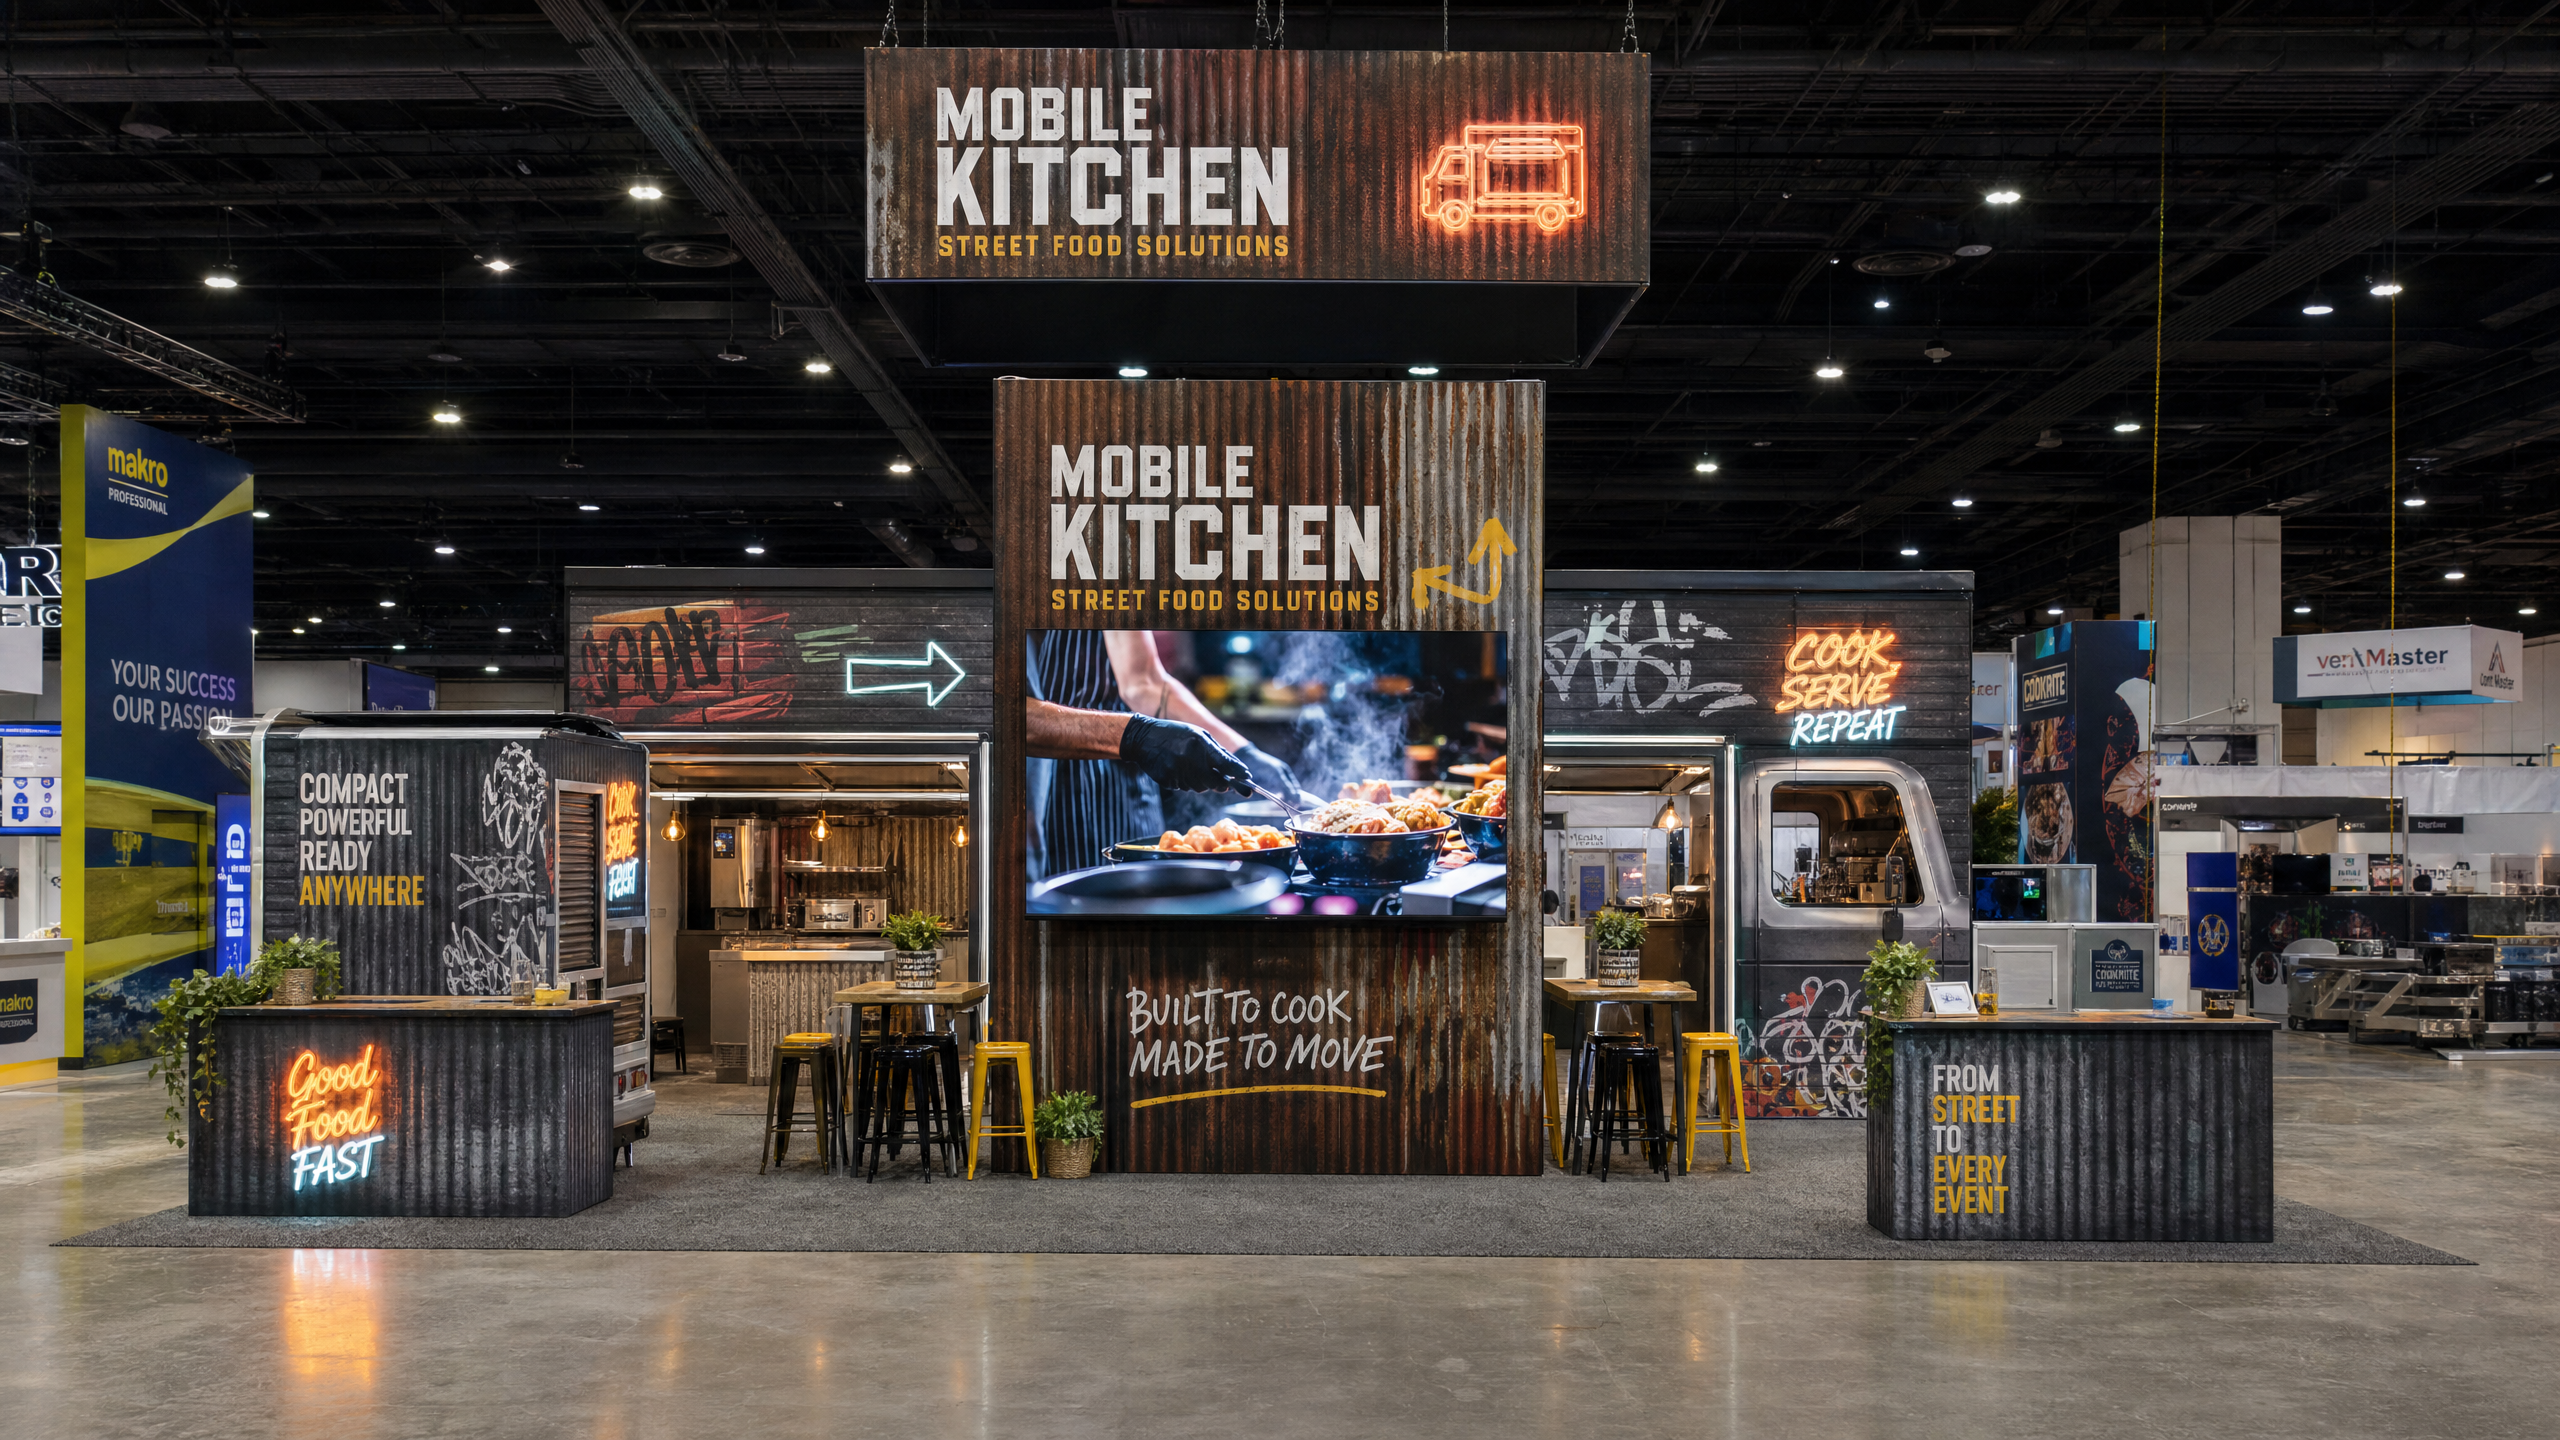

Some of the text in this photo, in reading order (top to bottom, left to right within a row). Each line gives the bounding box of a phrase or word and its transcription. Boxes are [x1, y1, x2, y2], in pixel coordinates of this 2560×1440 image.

[936, 87, 1152, 141] MOBILE
[936, 146, 1289, 226] KITCHEN
[938, 234, 1289, 257] STREET FOOD SOLUTIONS
[108, 446, 169, 488] makro
[1050, 444, 1254, 498] MOBILE
[108, 487, 169, 516] PROFESSIONAL
[1050, 503, 1381, 581] KITCHEN
[1051, 589, 1380, 612] STREET FOOD SOLUTIONS
[1785, 629, 1896, 673] COOK
[111, 658, 236, 702] YOUR SUCCESS
[1775, 668, 1899, 713] SERVE
[112, 694, 155, 725] OUR
[1790, 706, 1907, 747] REPEAT
[300, 772, 409, 804] COMPACT
[300, 808, 412, 836] POWERFUL
[300, 840, 372, 871] READY
[299, 875, 425, 906] ANYWHERE
[1126, 986, 1351, 1038] BUILT TO COOK
[1129, 1033, 1394, 1077] MADE TO MOVE
[288, 1044, 380, 1109] Good
[1933, 1064, 1999, 1092] FROM
[285, 1088, 379, 1150] Food
[1932, 1095, 2021, 1123] STREET
[1932, 1125, 1962, 1153] TO
[291, 1135, 385, 1191] FAST
[1933, 1155, 2007, 1184] EVERY
[1933, 1186, 2009, 1214] EVENT
